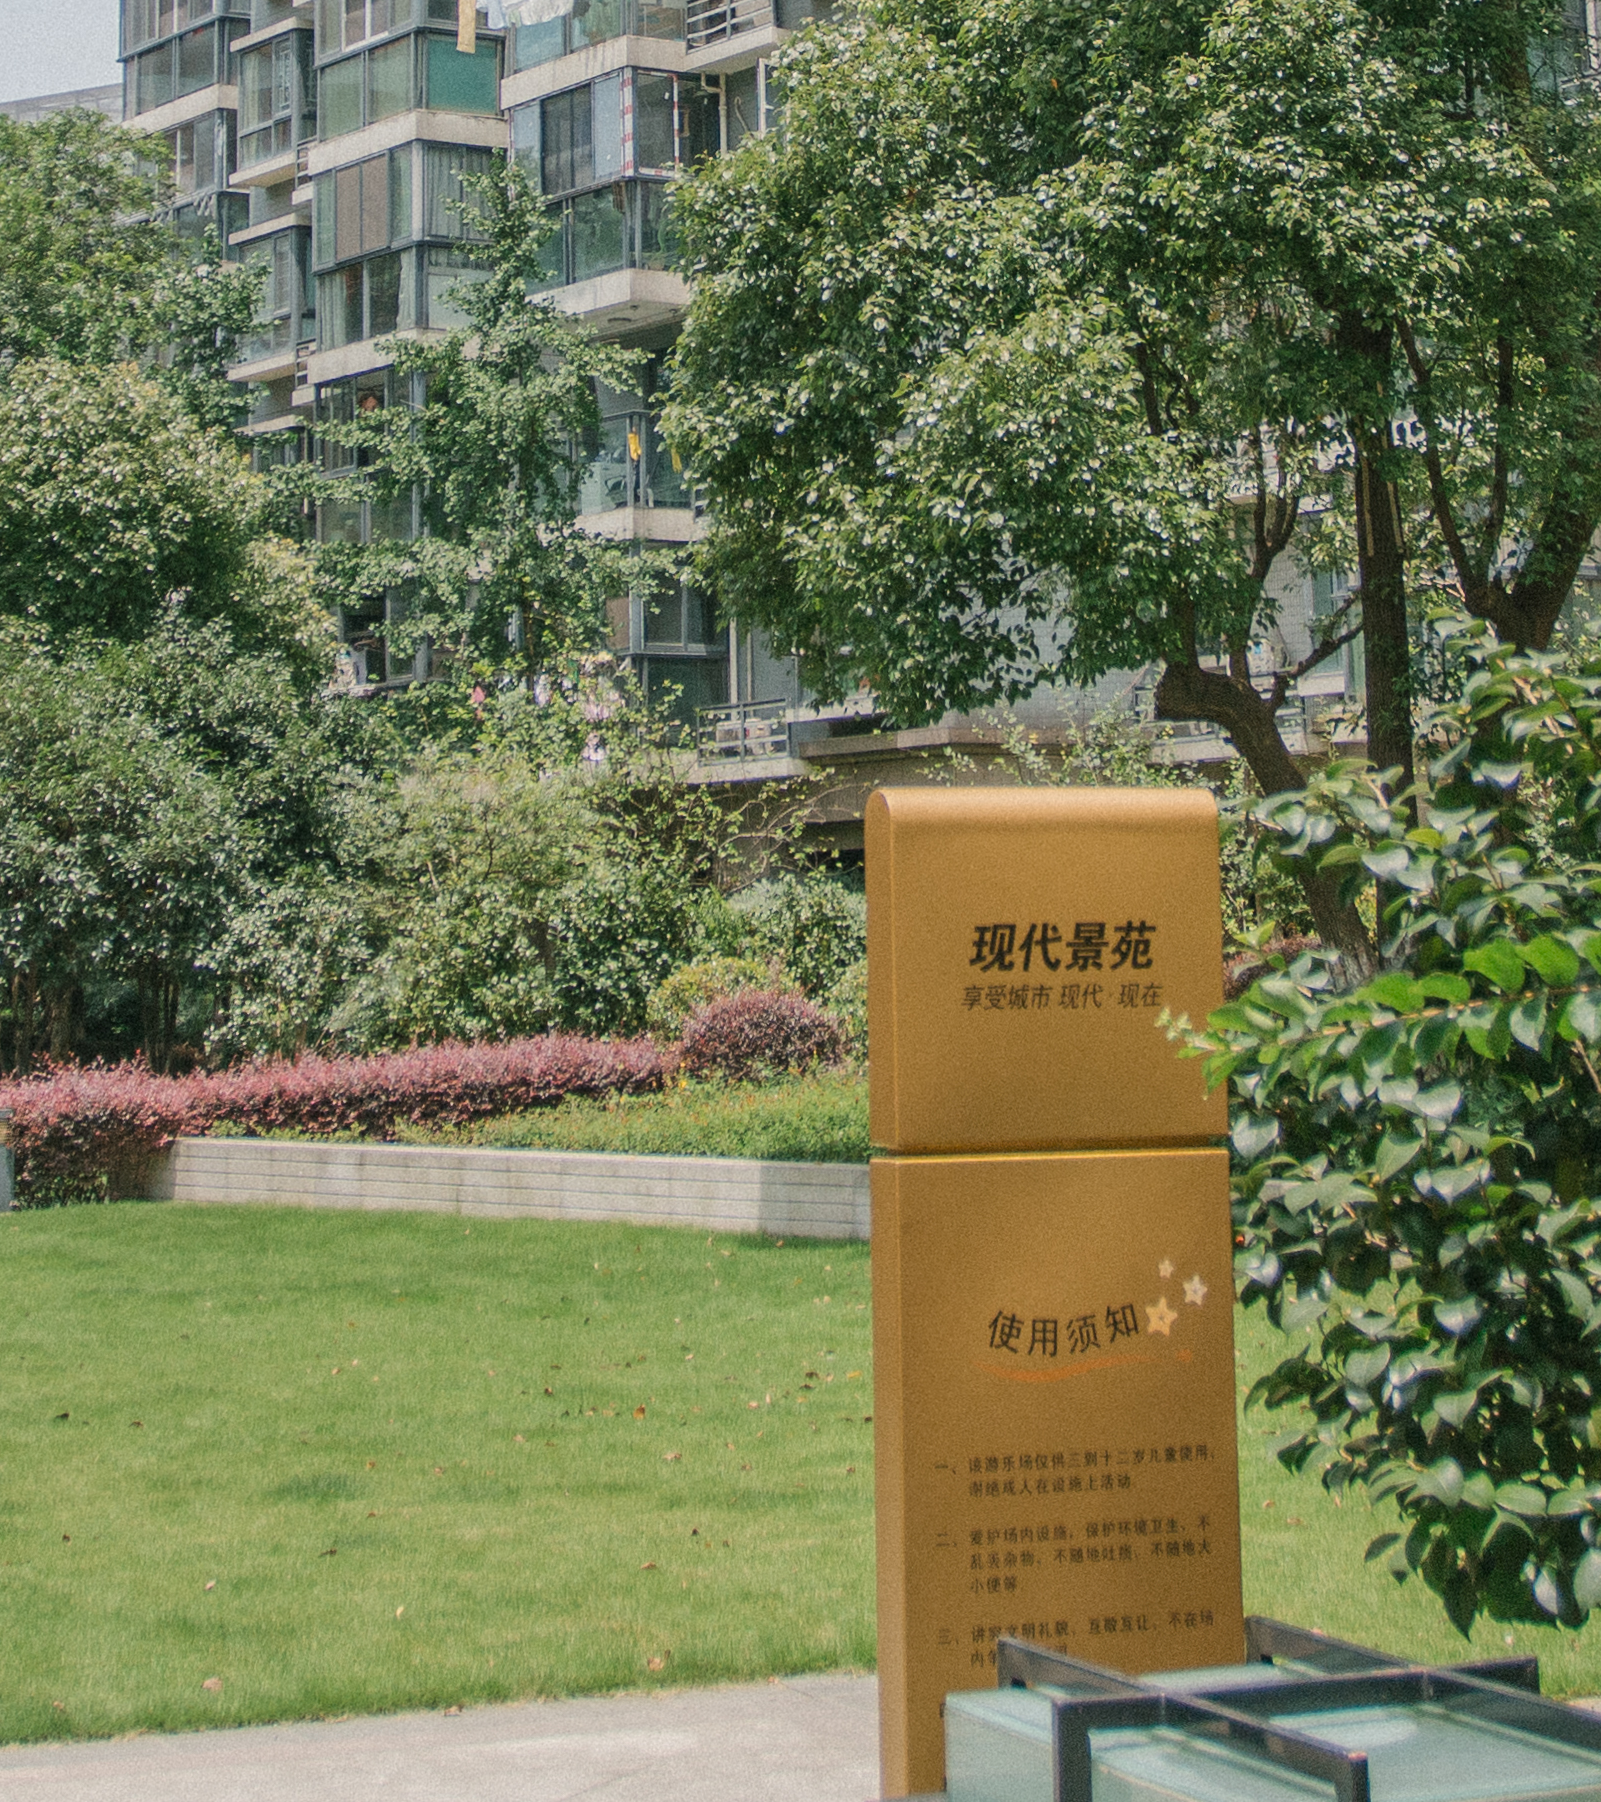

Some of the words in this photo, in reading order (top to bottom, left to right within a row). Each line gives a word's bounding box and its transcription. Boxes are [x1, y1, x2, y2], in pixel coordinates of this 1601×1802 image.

[969, 920, 1157, 973] 现代景苑
[961, 983, 1054, 1011] 享受城市
[988, 1302, 1141, 1358] 使用须知
